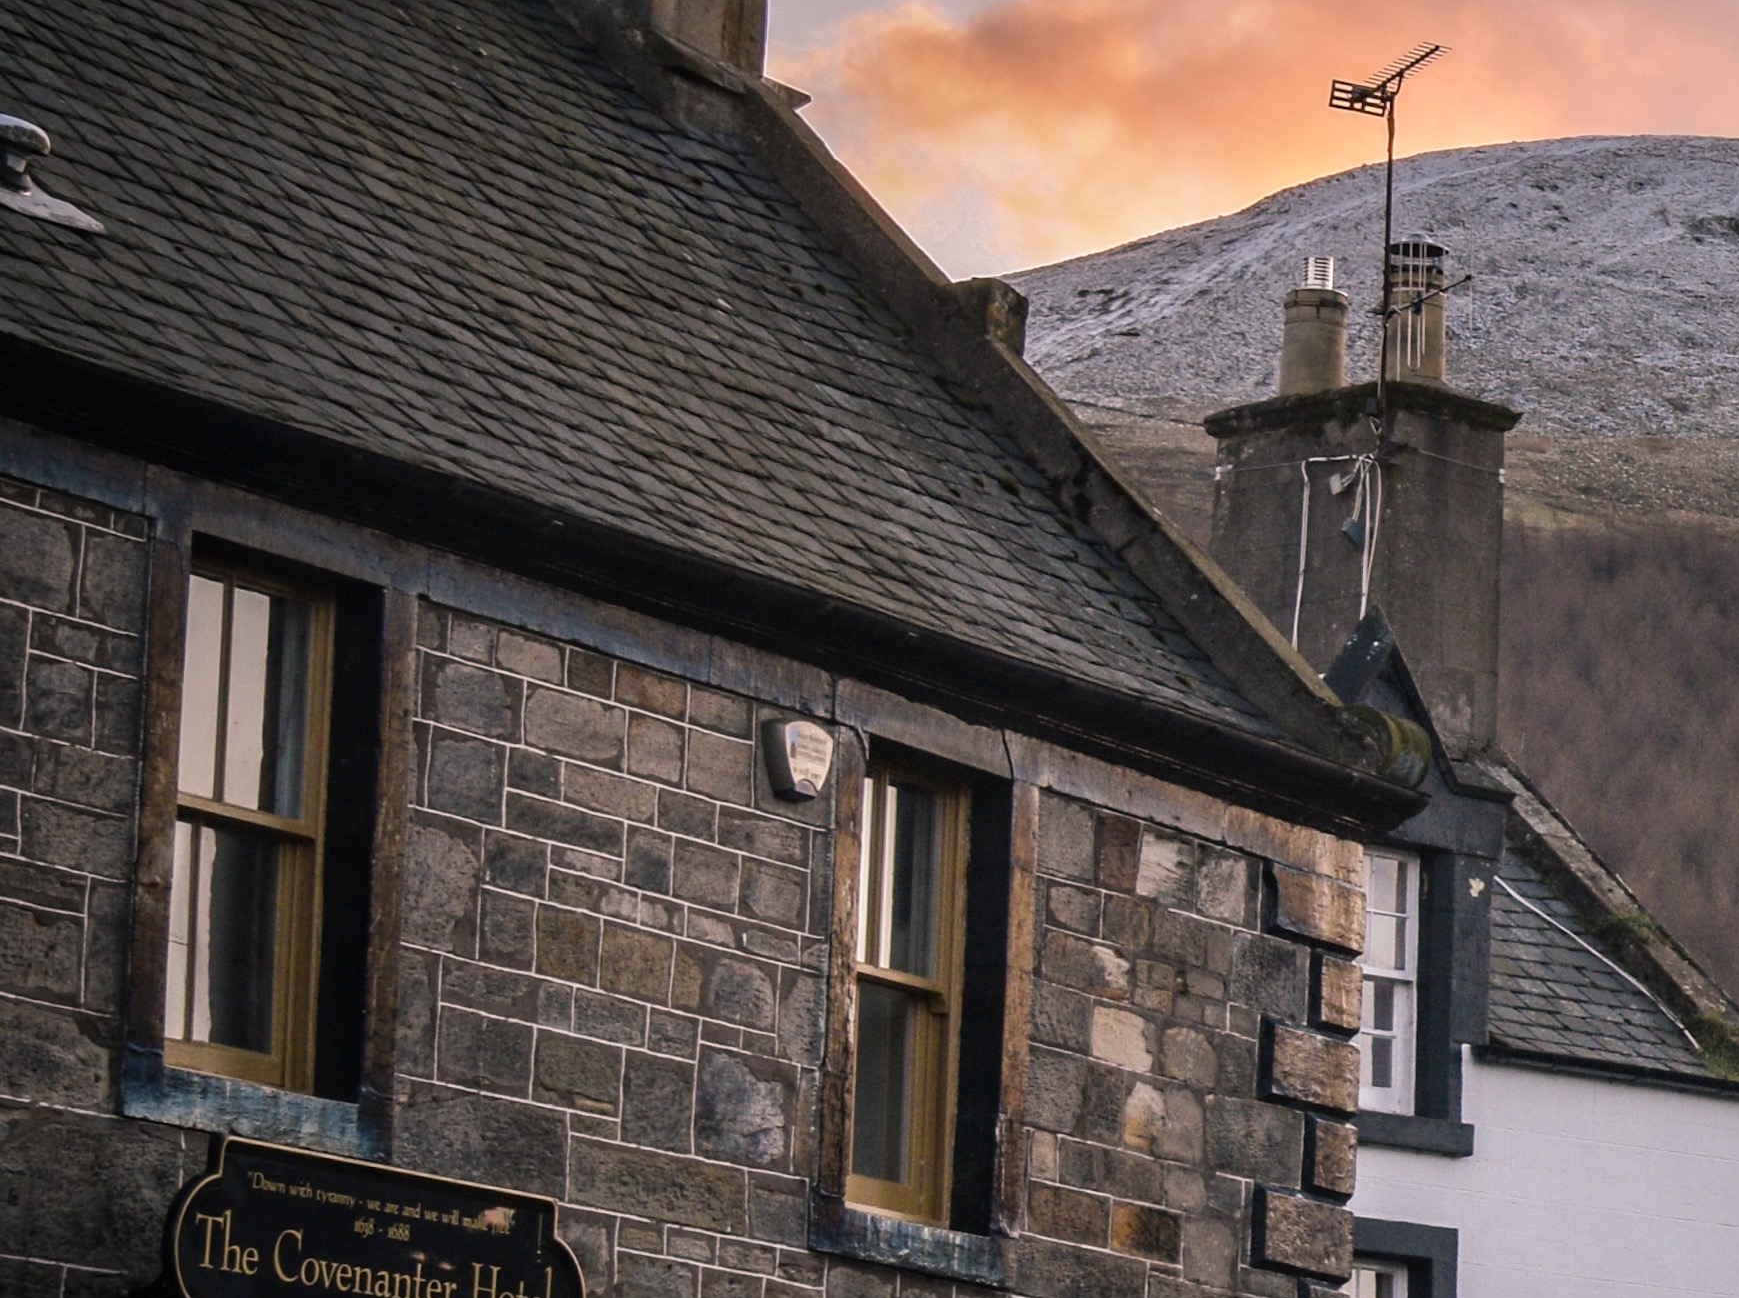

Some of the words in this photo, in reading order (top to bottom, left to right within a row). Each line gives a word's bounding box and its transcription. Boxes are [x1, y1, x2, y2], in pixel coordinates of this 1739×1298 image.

[289, 1181, 313, 1198] with
[316, 1189, 356, 1208] tyranny
[402, 1203, 421, 1219] and
[441, 1209, 460, 1226] will
[195, 1209, 259, 1276] The
